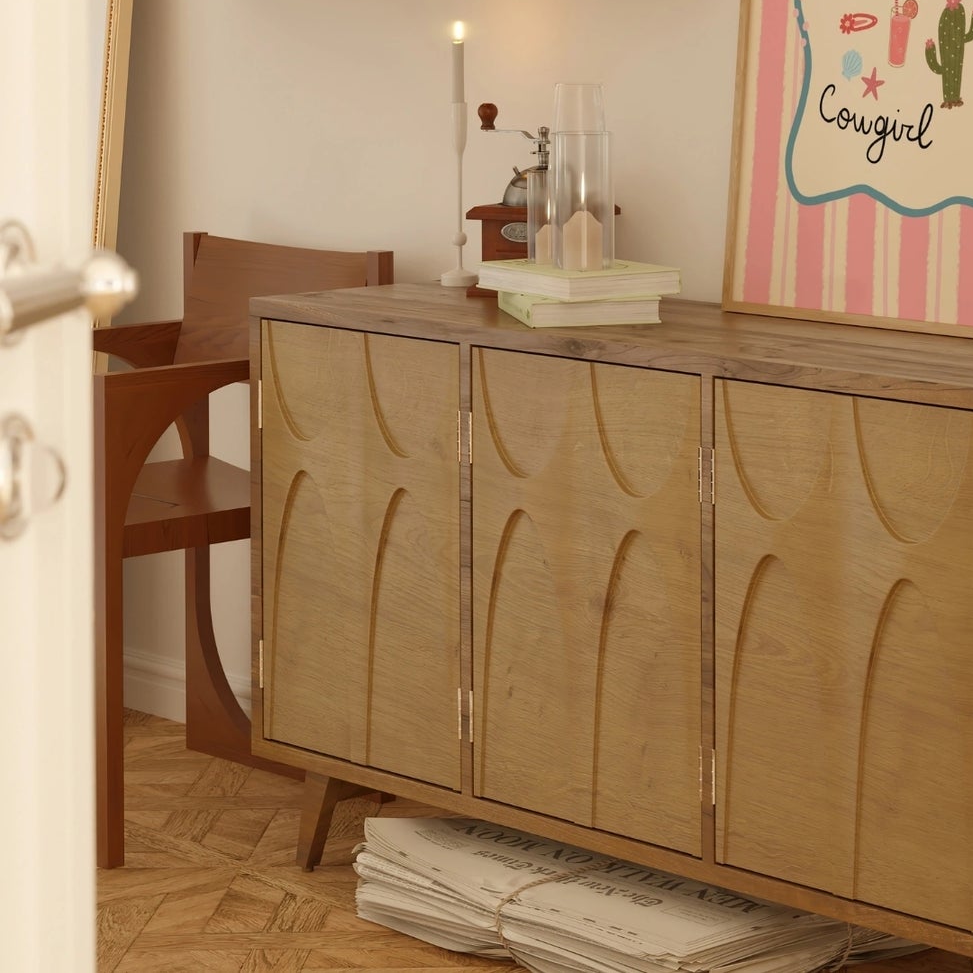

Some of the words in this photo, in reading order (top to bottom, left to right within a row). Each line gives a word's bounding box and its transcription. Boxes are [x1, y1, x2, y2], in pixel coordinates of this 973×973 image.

[819, 84, 933, 163] Cowgirl
[455, 825, 543, 852] MOON
[472, 850, 534, 870] Times
[541, 847, 594, 865] ON
[530, 865, 589, 885] Yrk
[622, 891, 664, 908] The
[683, 887, 770, 914] MEN
